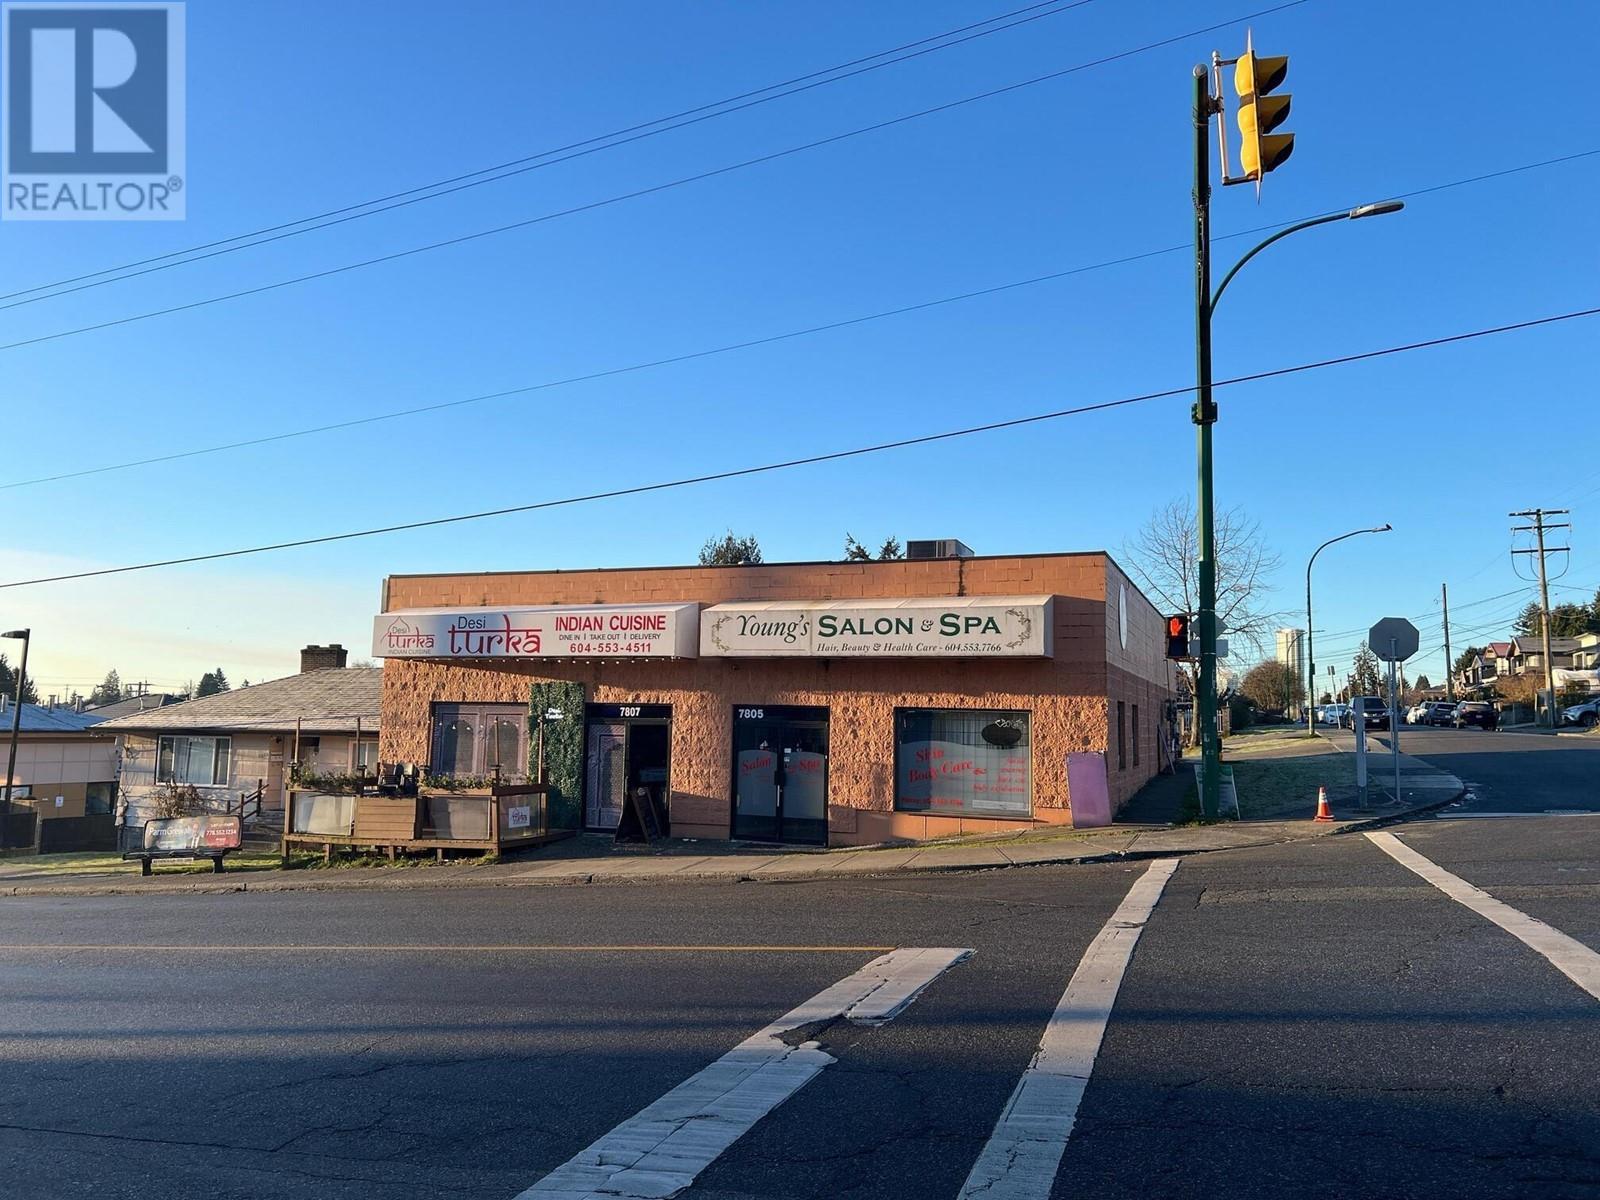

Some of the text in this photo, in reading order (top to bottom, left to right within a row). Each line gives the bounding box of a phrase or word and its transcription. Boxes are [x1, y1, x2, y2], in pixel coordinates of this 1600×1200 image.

[458, 616, 486, 629] Desi
[555, 615, 667, 631] INDIAN CUISINE
[736, 614, 810, 643] Young's
[920, 619, 934, 632] &
[388, 626, 435, 649] turka
[448, 612, 542, 654] turka
[570, 642, 651, 653] 604-553-4511
[817, 643, 839, 653] Hair,
[841, 643, 871, 653] Beauty
[883, 642, 913, 652] Health
[915, 642, 938, 652] Care
[944, 643, 1002, 652] 604.553.7766
[620, 707, 640, 717] 7807
[738, 708, 764, 719] 7805
